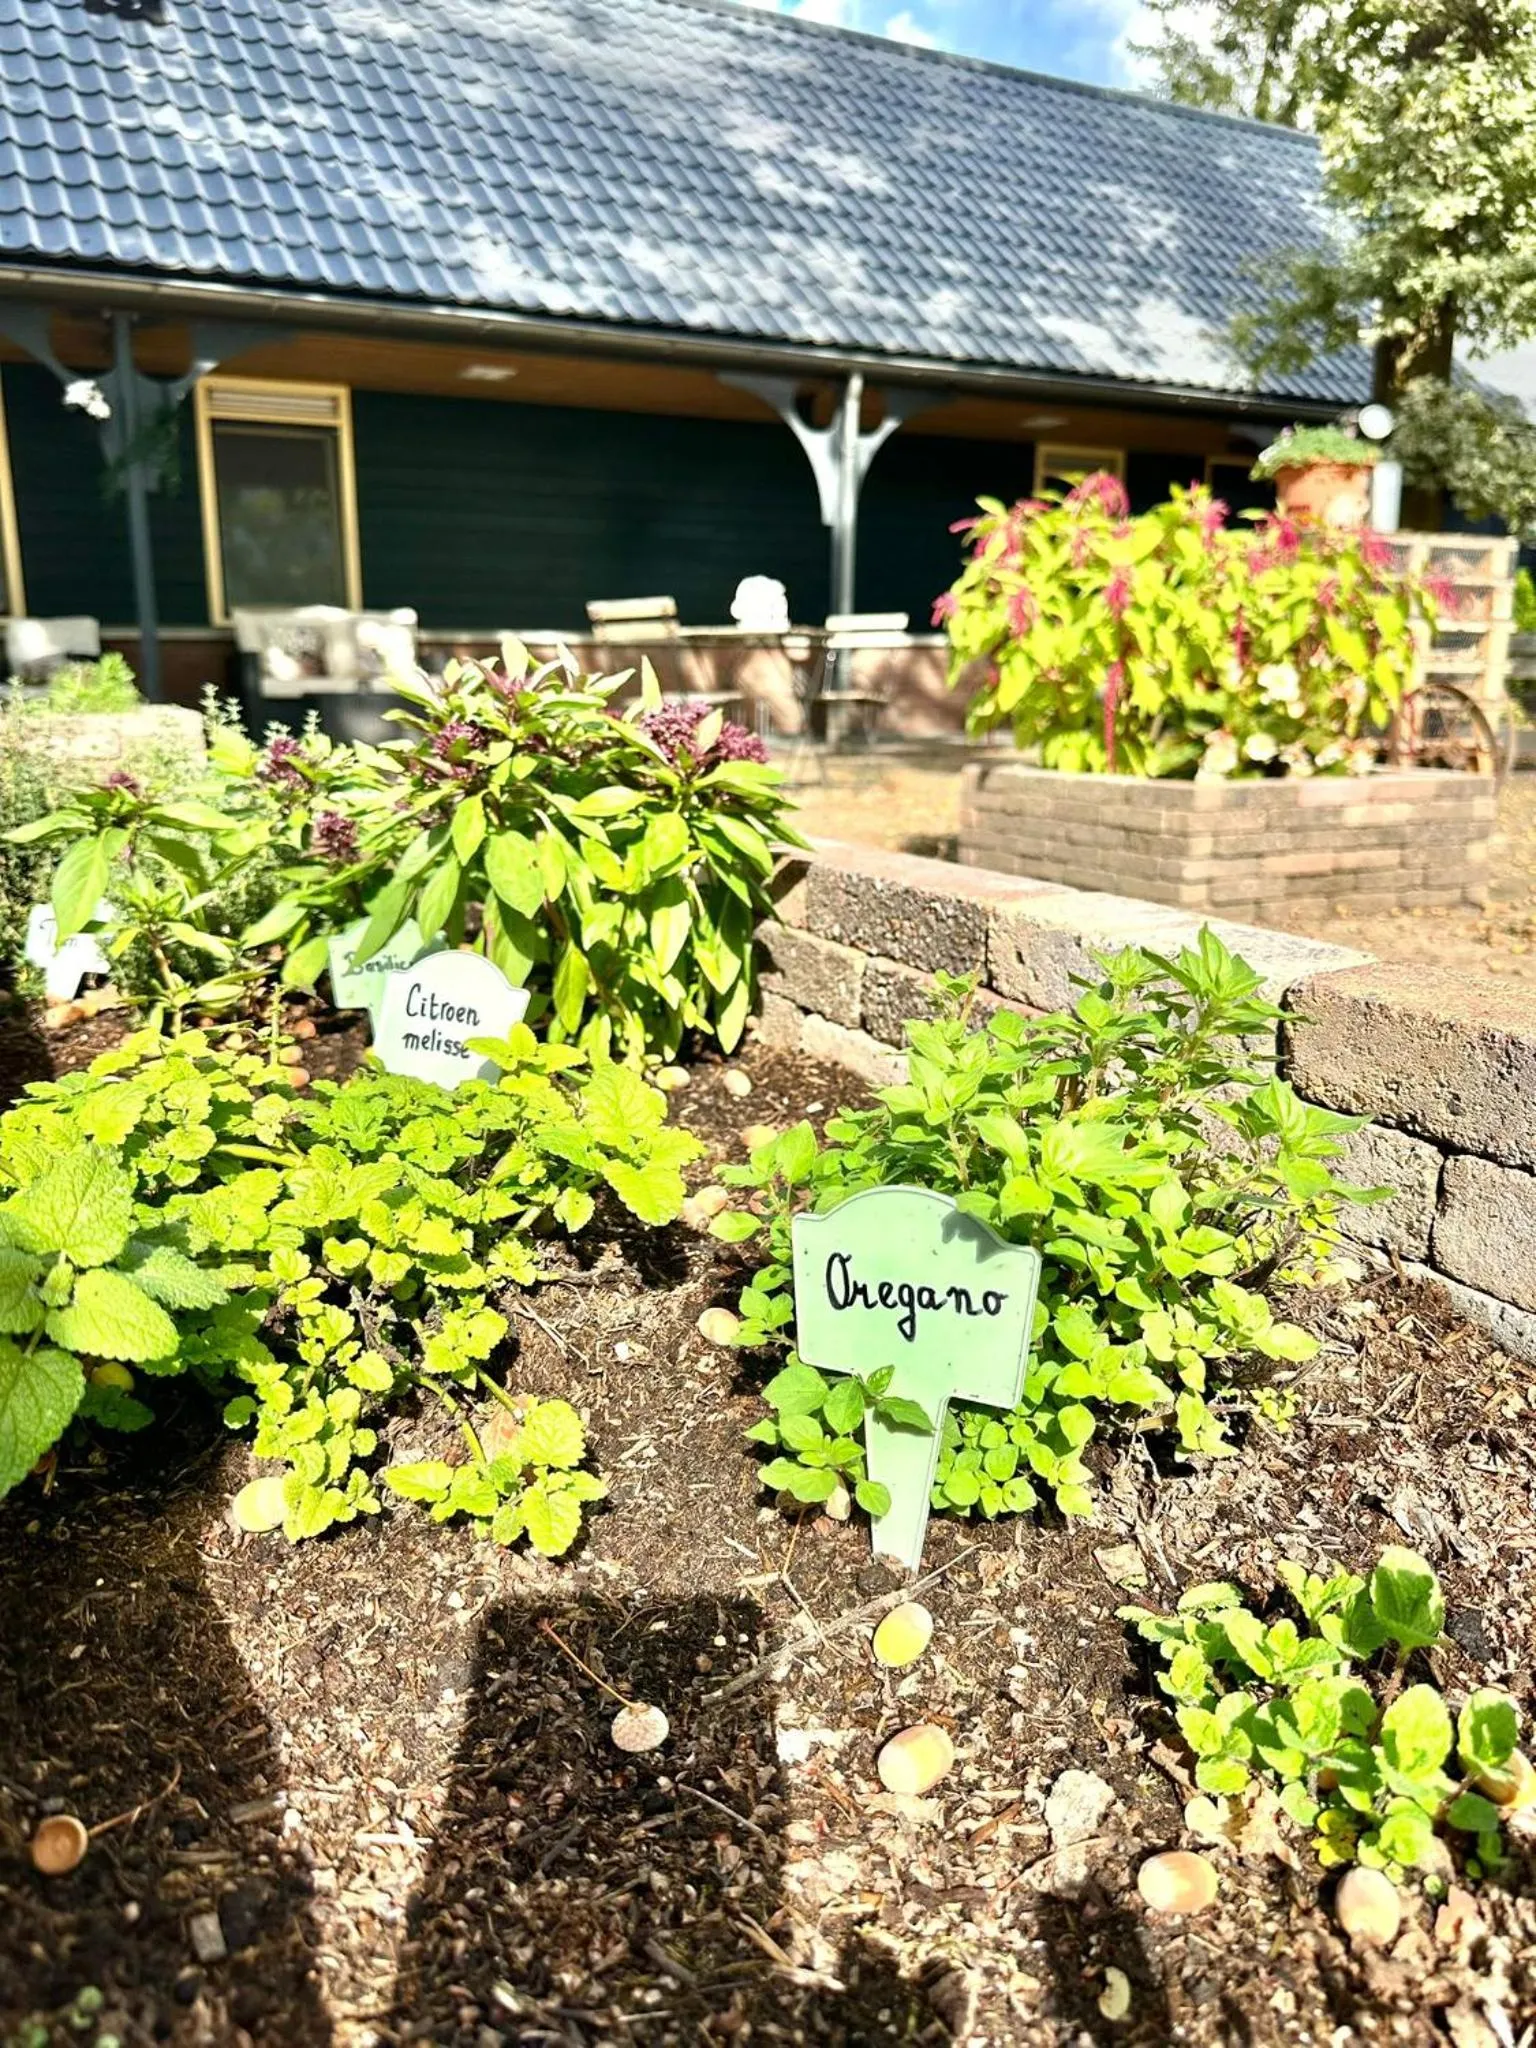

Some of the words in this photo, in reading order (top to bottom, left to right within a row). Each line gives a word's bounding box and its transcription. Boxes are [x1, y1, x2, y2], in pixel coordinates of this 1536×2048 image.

[406, 983, 480, 1026] Citroen
[402, 1028, 470, 1059] melisse
[826, 1252, 1009, 1342] Oregano
